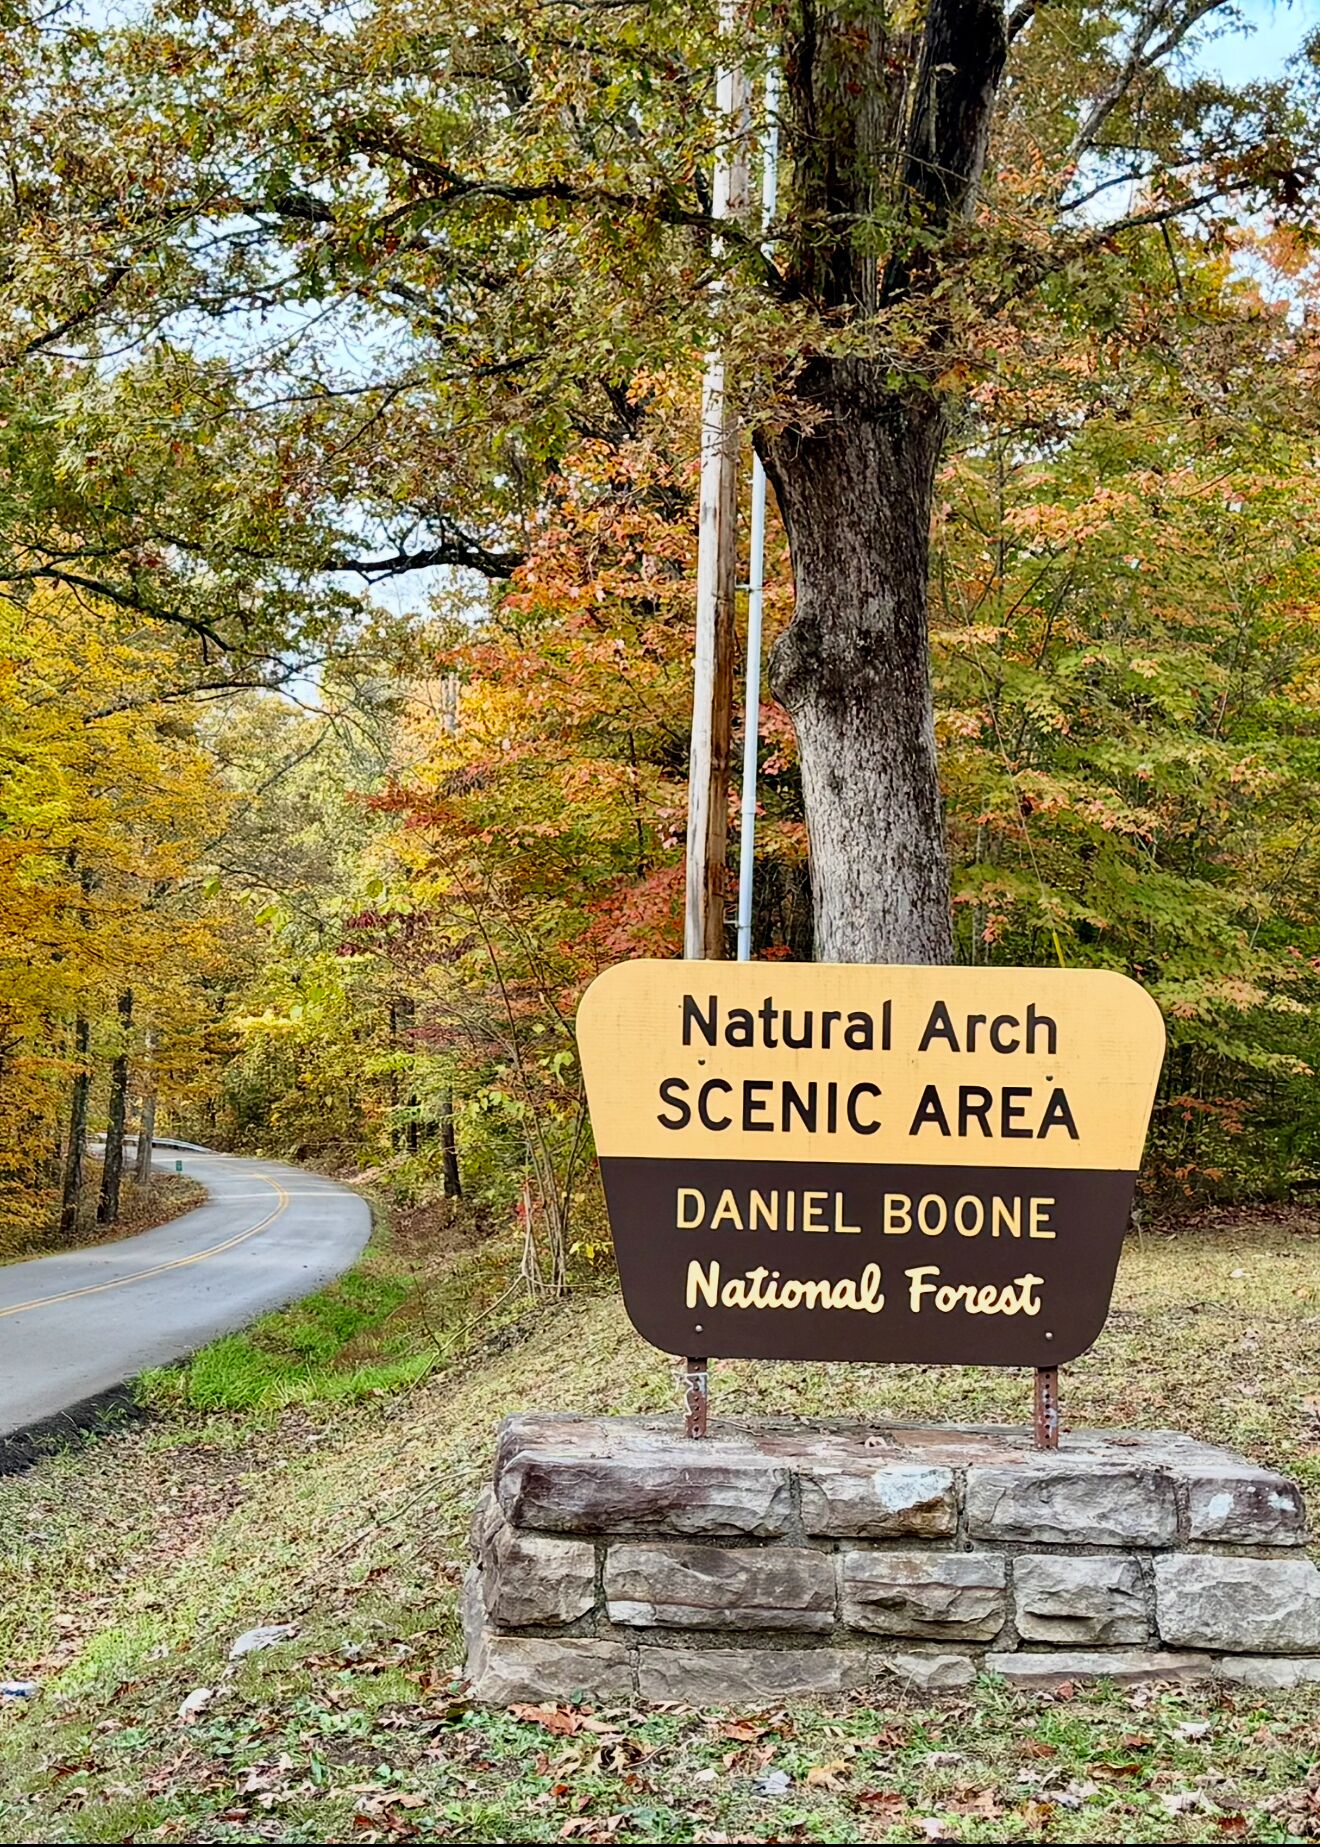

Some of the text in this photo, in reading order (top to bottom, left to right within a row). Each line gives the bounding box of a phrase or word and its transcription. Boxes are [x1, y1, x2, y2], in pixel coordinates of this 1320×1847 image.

[683, 995, 1057, 1054] Natural Arch
[657, 1078, 1079, 1139] SCENIC AREA
[676, 1188, 1056, 1239] DANIEL BOONE
[686, 1261, 1045, 1316] National Forest
